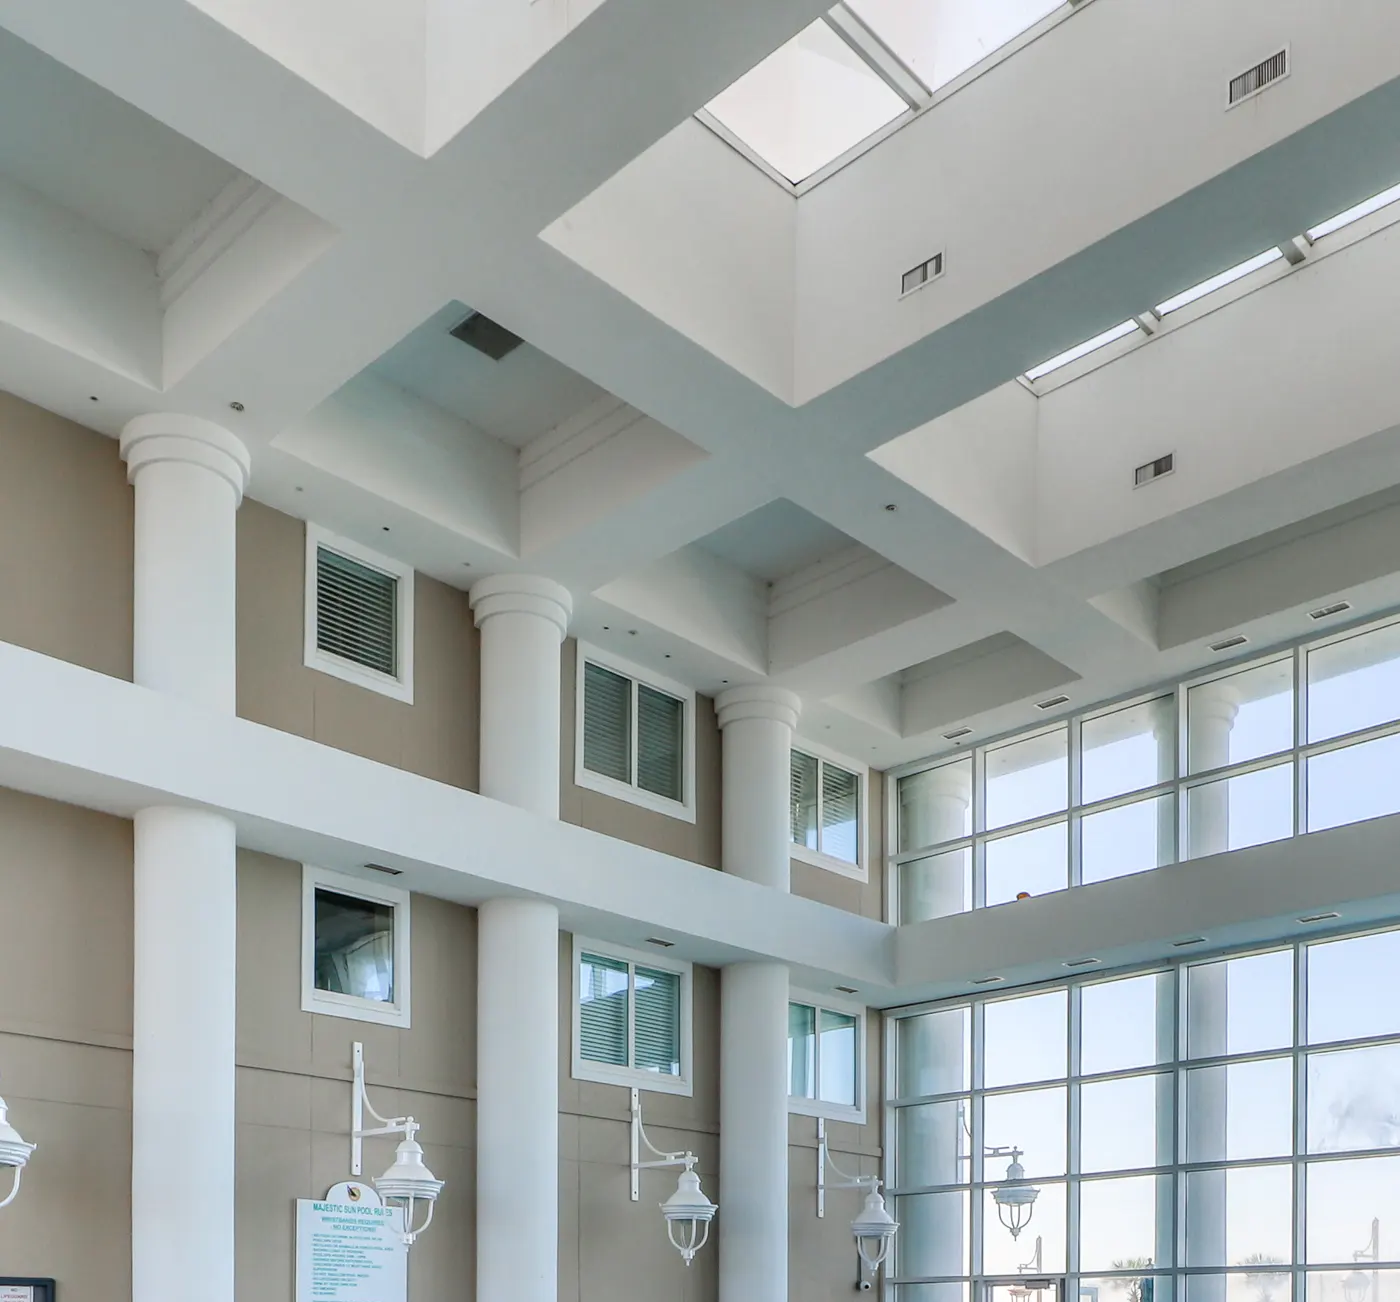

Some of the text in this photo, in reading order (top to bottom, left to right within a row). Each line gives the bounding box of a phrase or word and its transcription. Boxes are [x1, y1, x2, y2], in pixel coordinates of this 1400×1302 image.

[313, 1203, 393, 1217] MAJESTIC SUN POOL RUES
